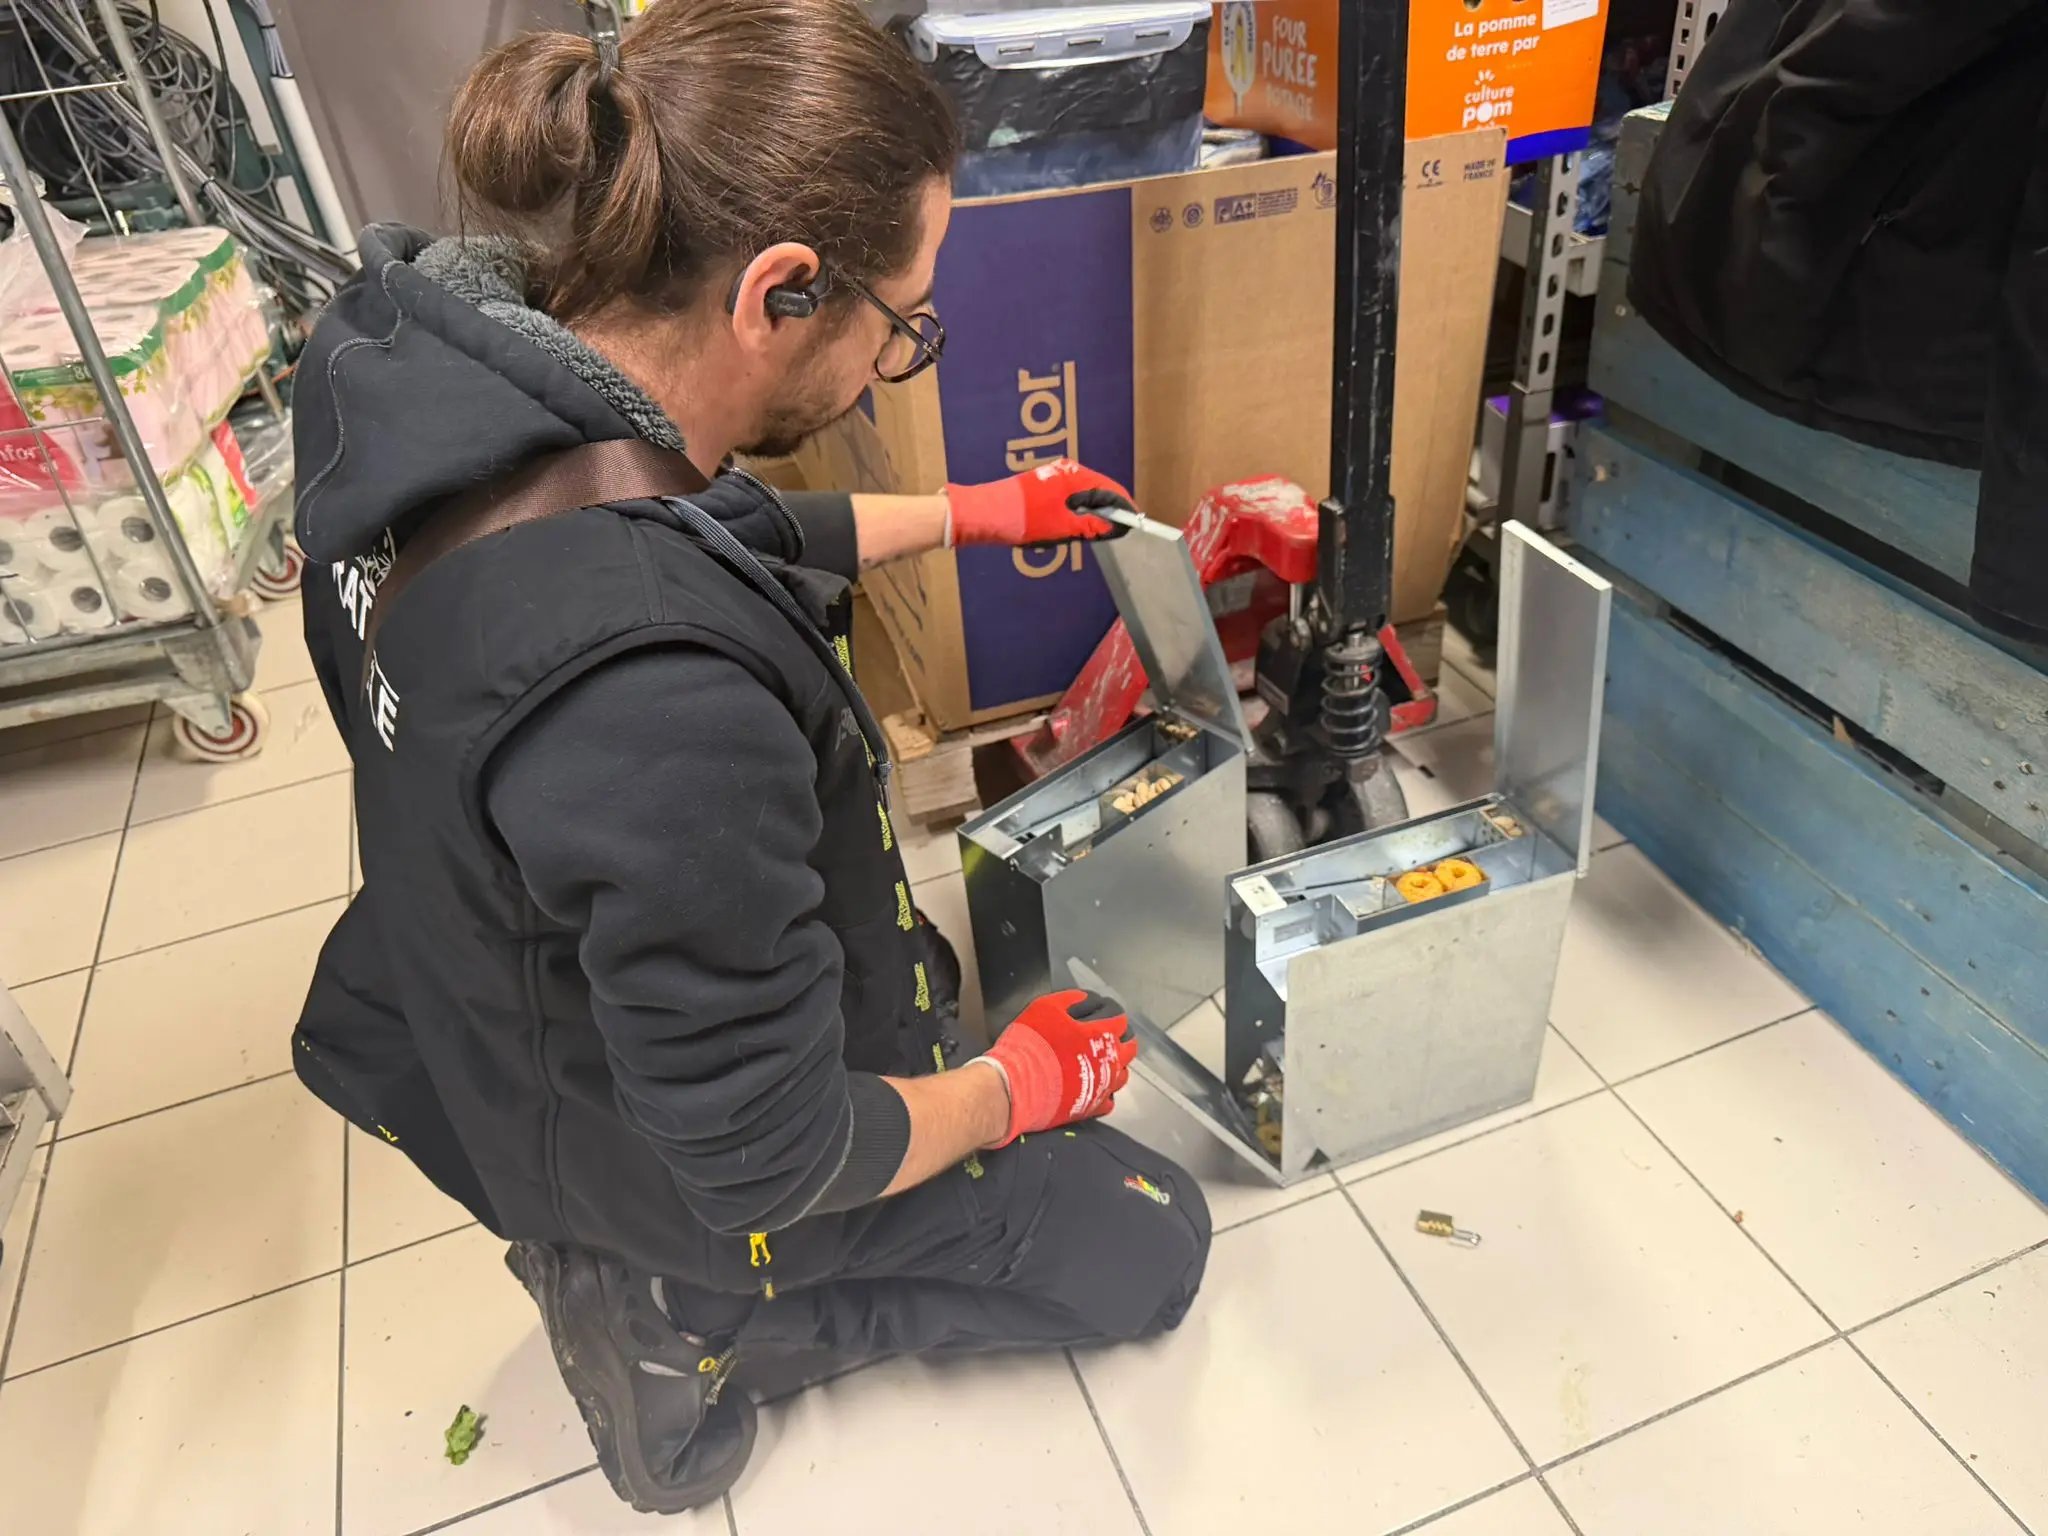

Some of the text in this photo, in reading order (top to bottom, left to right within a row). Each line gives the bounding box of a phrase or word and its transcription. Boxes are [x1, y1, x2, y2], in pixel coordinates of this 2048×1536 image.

[1272, 15, 1308, 49] FOUR
[1454, 13, 1537, 38] La pomme
[1446, 35, 1540, 61] de terre par
[1464, 85, 1514, 104] culture
[1422, 159, 1441, 178] CE
[1006, 367, 1069, 578] Gflor
